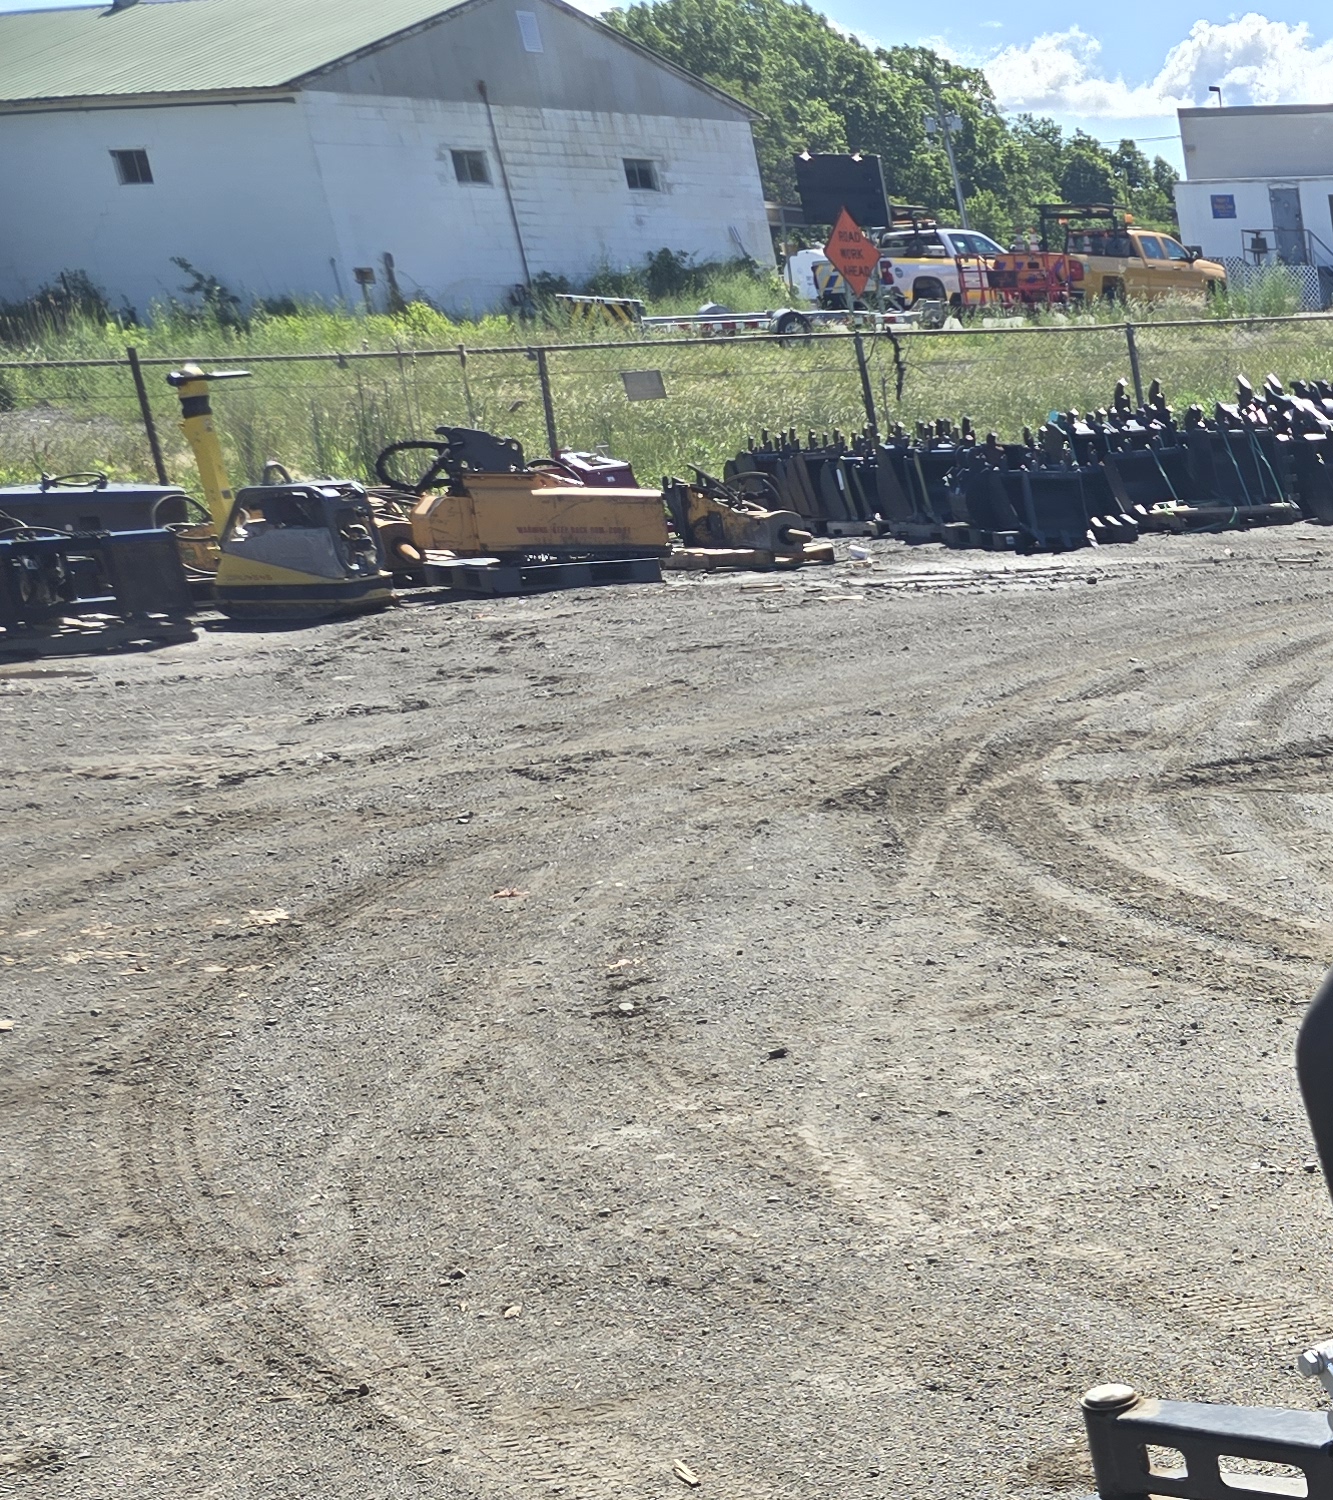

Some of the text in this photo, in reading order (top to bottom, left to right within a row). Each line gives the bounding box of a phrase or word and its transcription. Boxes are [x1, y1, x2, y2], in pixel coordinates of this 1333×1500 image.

[838, 231, 861, 243] ROAD
[840, 248, 865, 259] WORK
[844, 265, 870, 277] AHEAD
